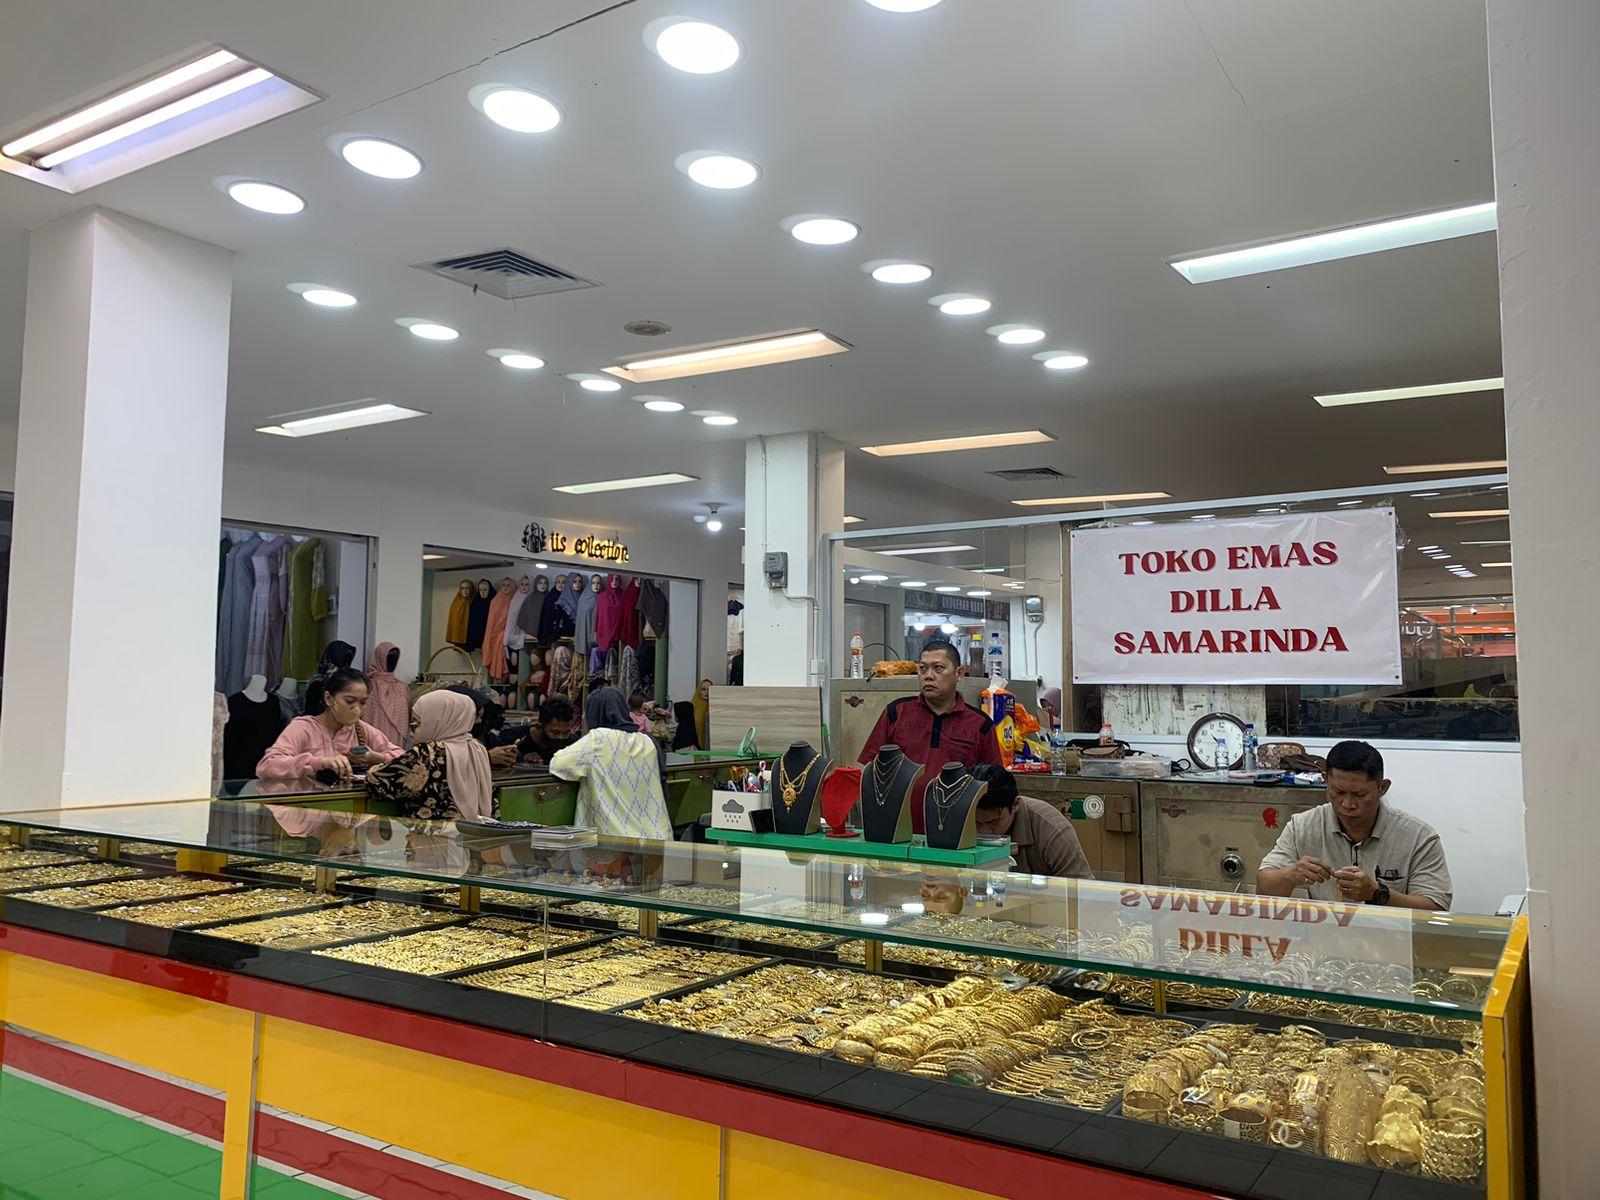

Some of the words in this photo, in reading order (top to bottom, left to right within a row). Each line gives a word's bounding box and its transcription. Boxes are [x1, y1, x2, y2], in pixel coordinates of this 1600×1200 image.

[575, 534, 629, 560] collection
[1118, 548, 1216, 575] TOKO
[1227, 541, 1338, 569] EMAS
[1170, 586, 1281, 613] DILLA
[1114, 626, 1348, 655] SAMARINDA
